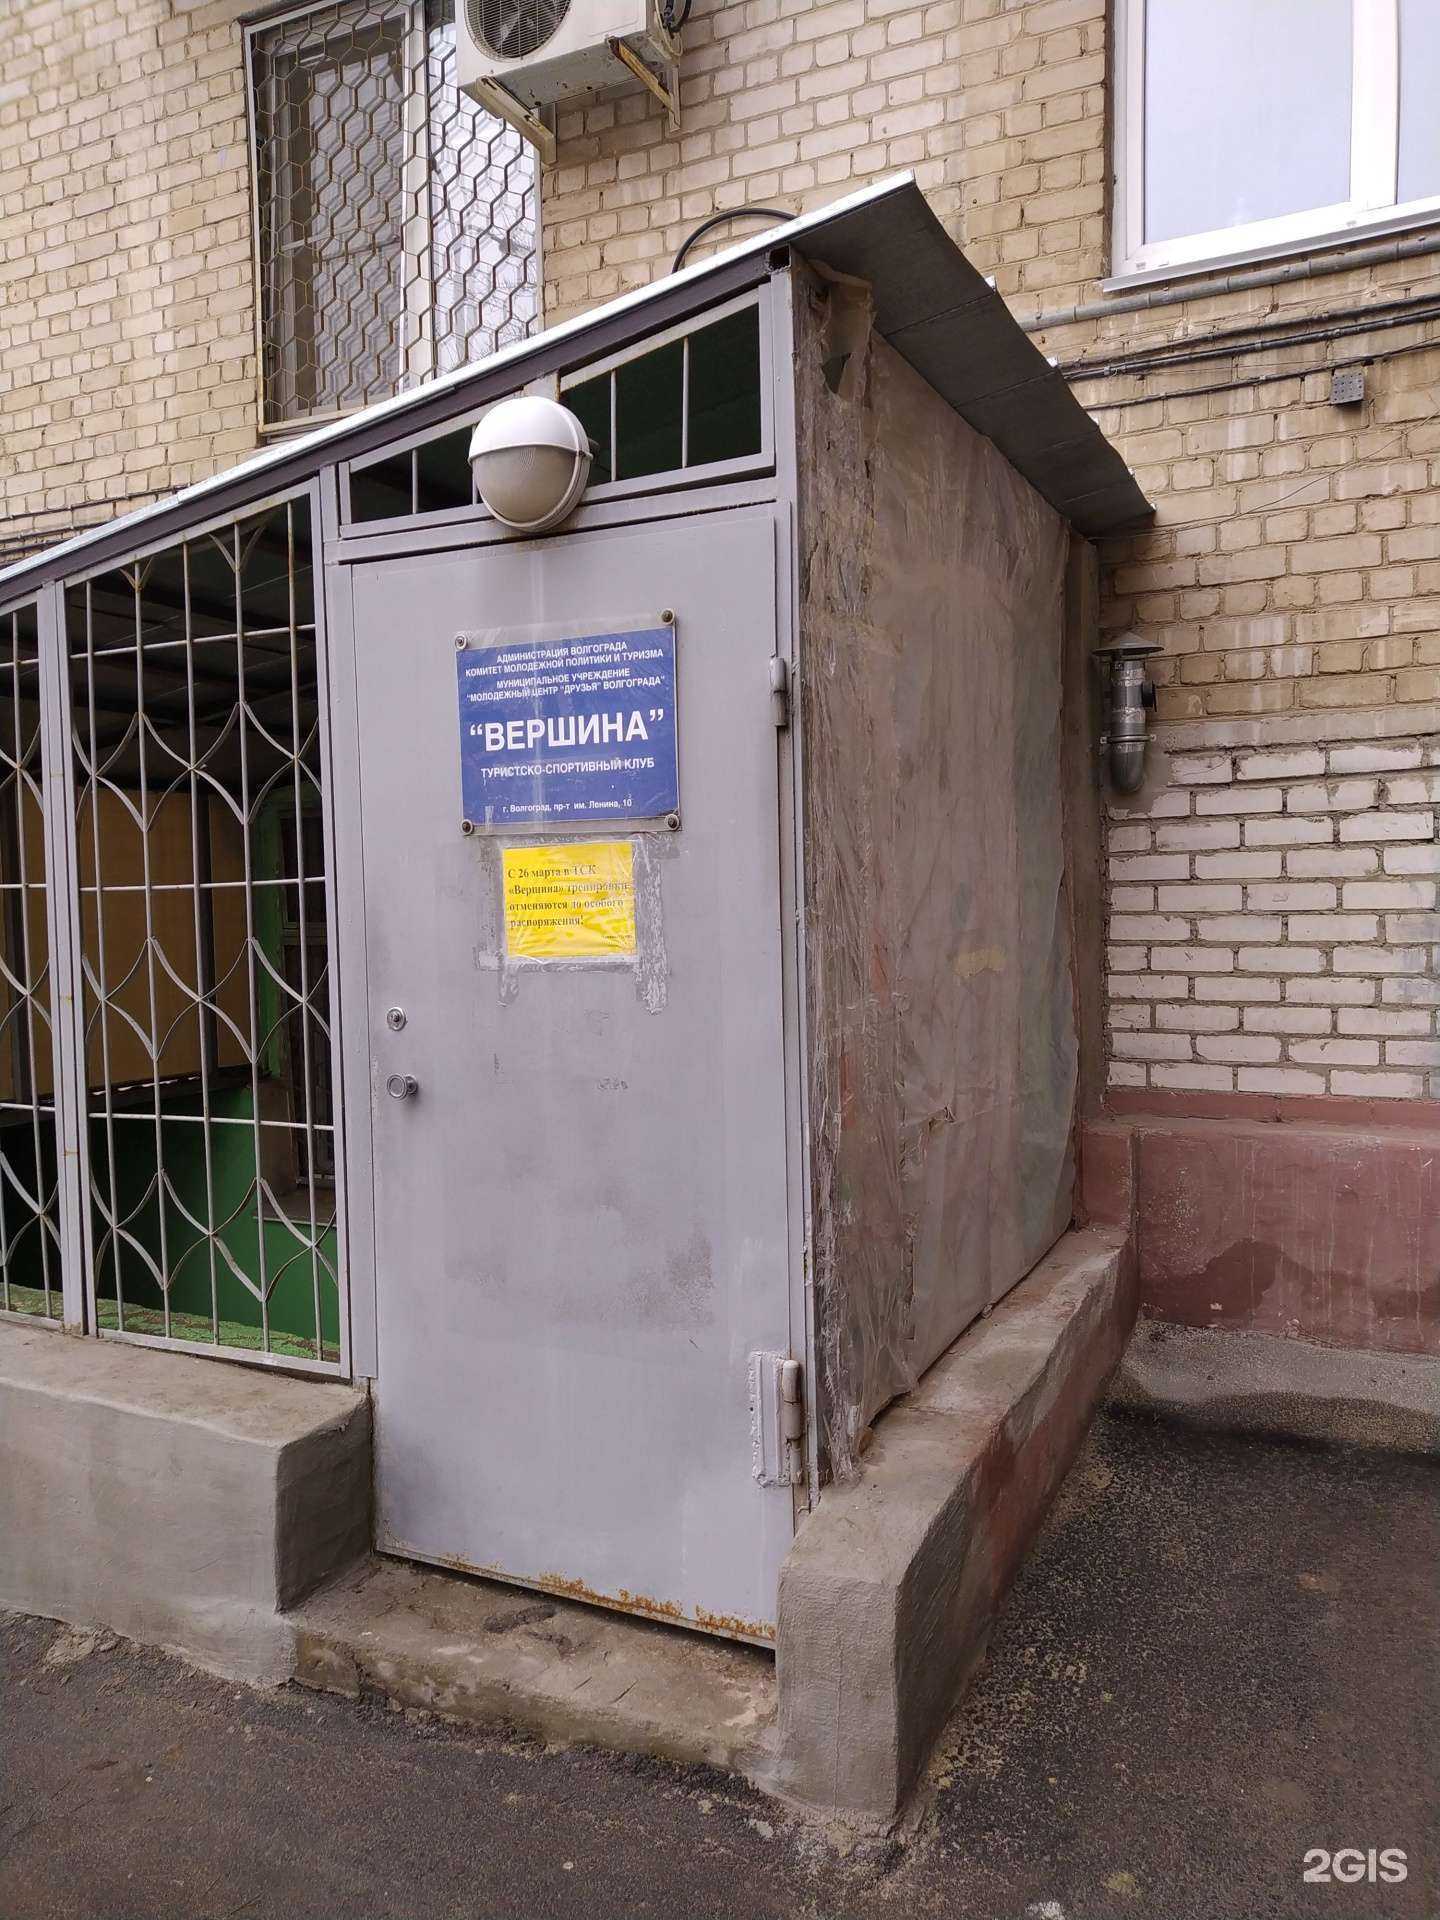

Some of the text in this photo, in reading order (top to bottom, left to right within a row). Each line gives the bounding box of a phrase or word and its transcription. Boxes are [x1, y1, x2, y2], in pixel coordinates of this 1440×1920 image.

[496, 641, 628, 664] АДМИНИСТРАЦИЯ ВОЛГОГРАДА
[465, 648, 664, 677] КОМИТЕТ МОЛОДЕЖНОЙ ПОЛИТИКИ И ТУРИЗМА
[496, 667, 631, 689] МУНИЦИПАЛЬНОЕ УЧРЕЖДЕНИЕ
[532, 686, 559, 698] ЦЕНТР
[469, 709, 664, 751] “ВЕРШИНА”
[480, 757, 656, 779] ТУРИСТСКО-СПОРТИВНЫЙ КЛУБ
[553, 802, 570, 812] пр-т
[574, 801, 587, 810] им.
[508, 869, 515, 878] С
[518, 868, 529, 878] 26
[531, 868, 561, 879] марта
[564, 868, 569, 876] в
[509, 882, 563, 896] «Вершина»
[509, 900, 568, 912] отменяются
[510, 914, 584, 929] распоряжения!
